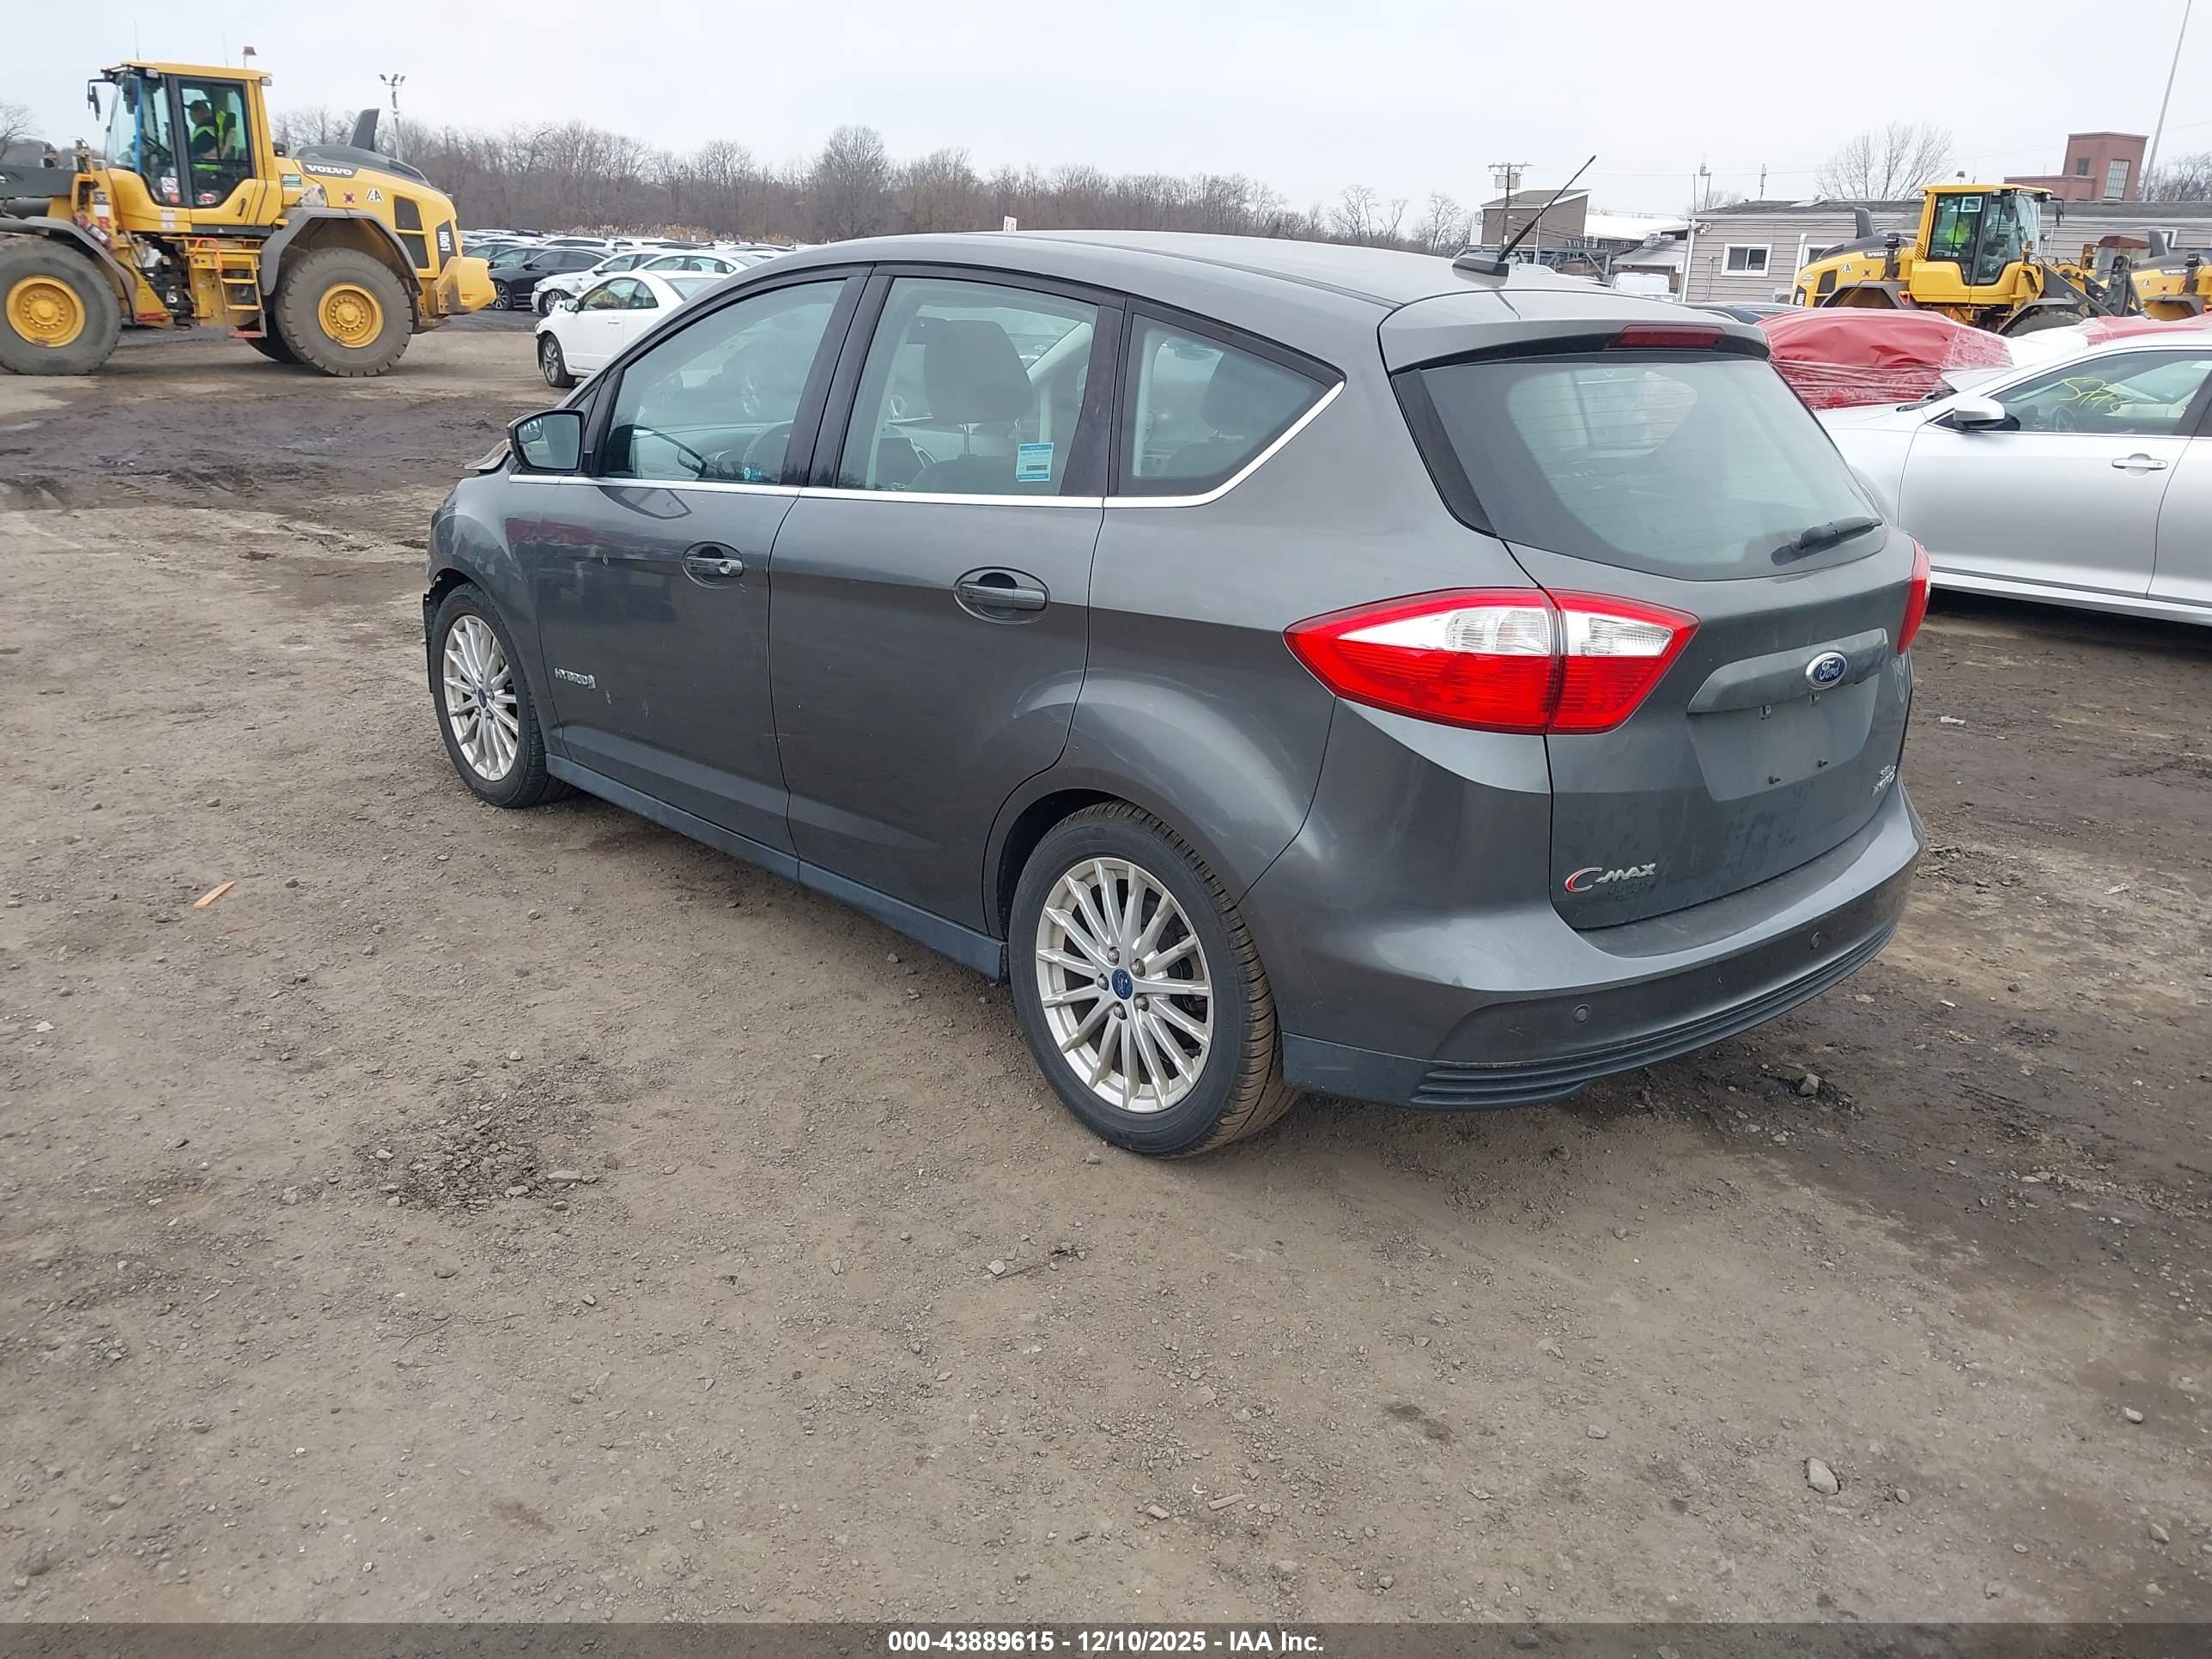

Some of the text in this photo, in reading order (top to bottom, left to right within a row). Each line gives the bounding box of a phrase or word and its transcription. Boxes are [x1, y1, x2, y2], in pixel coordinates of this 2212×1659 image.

[306, 164, 353, 175] VOLVO
[439, 232, 451, 252] L90H
[1819, 659, 1841, 681] Ford
